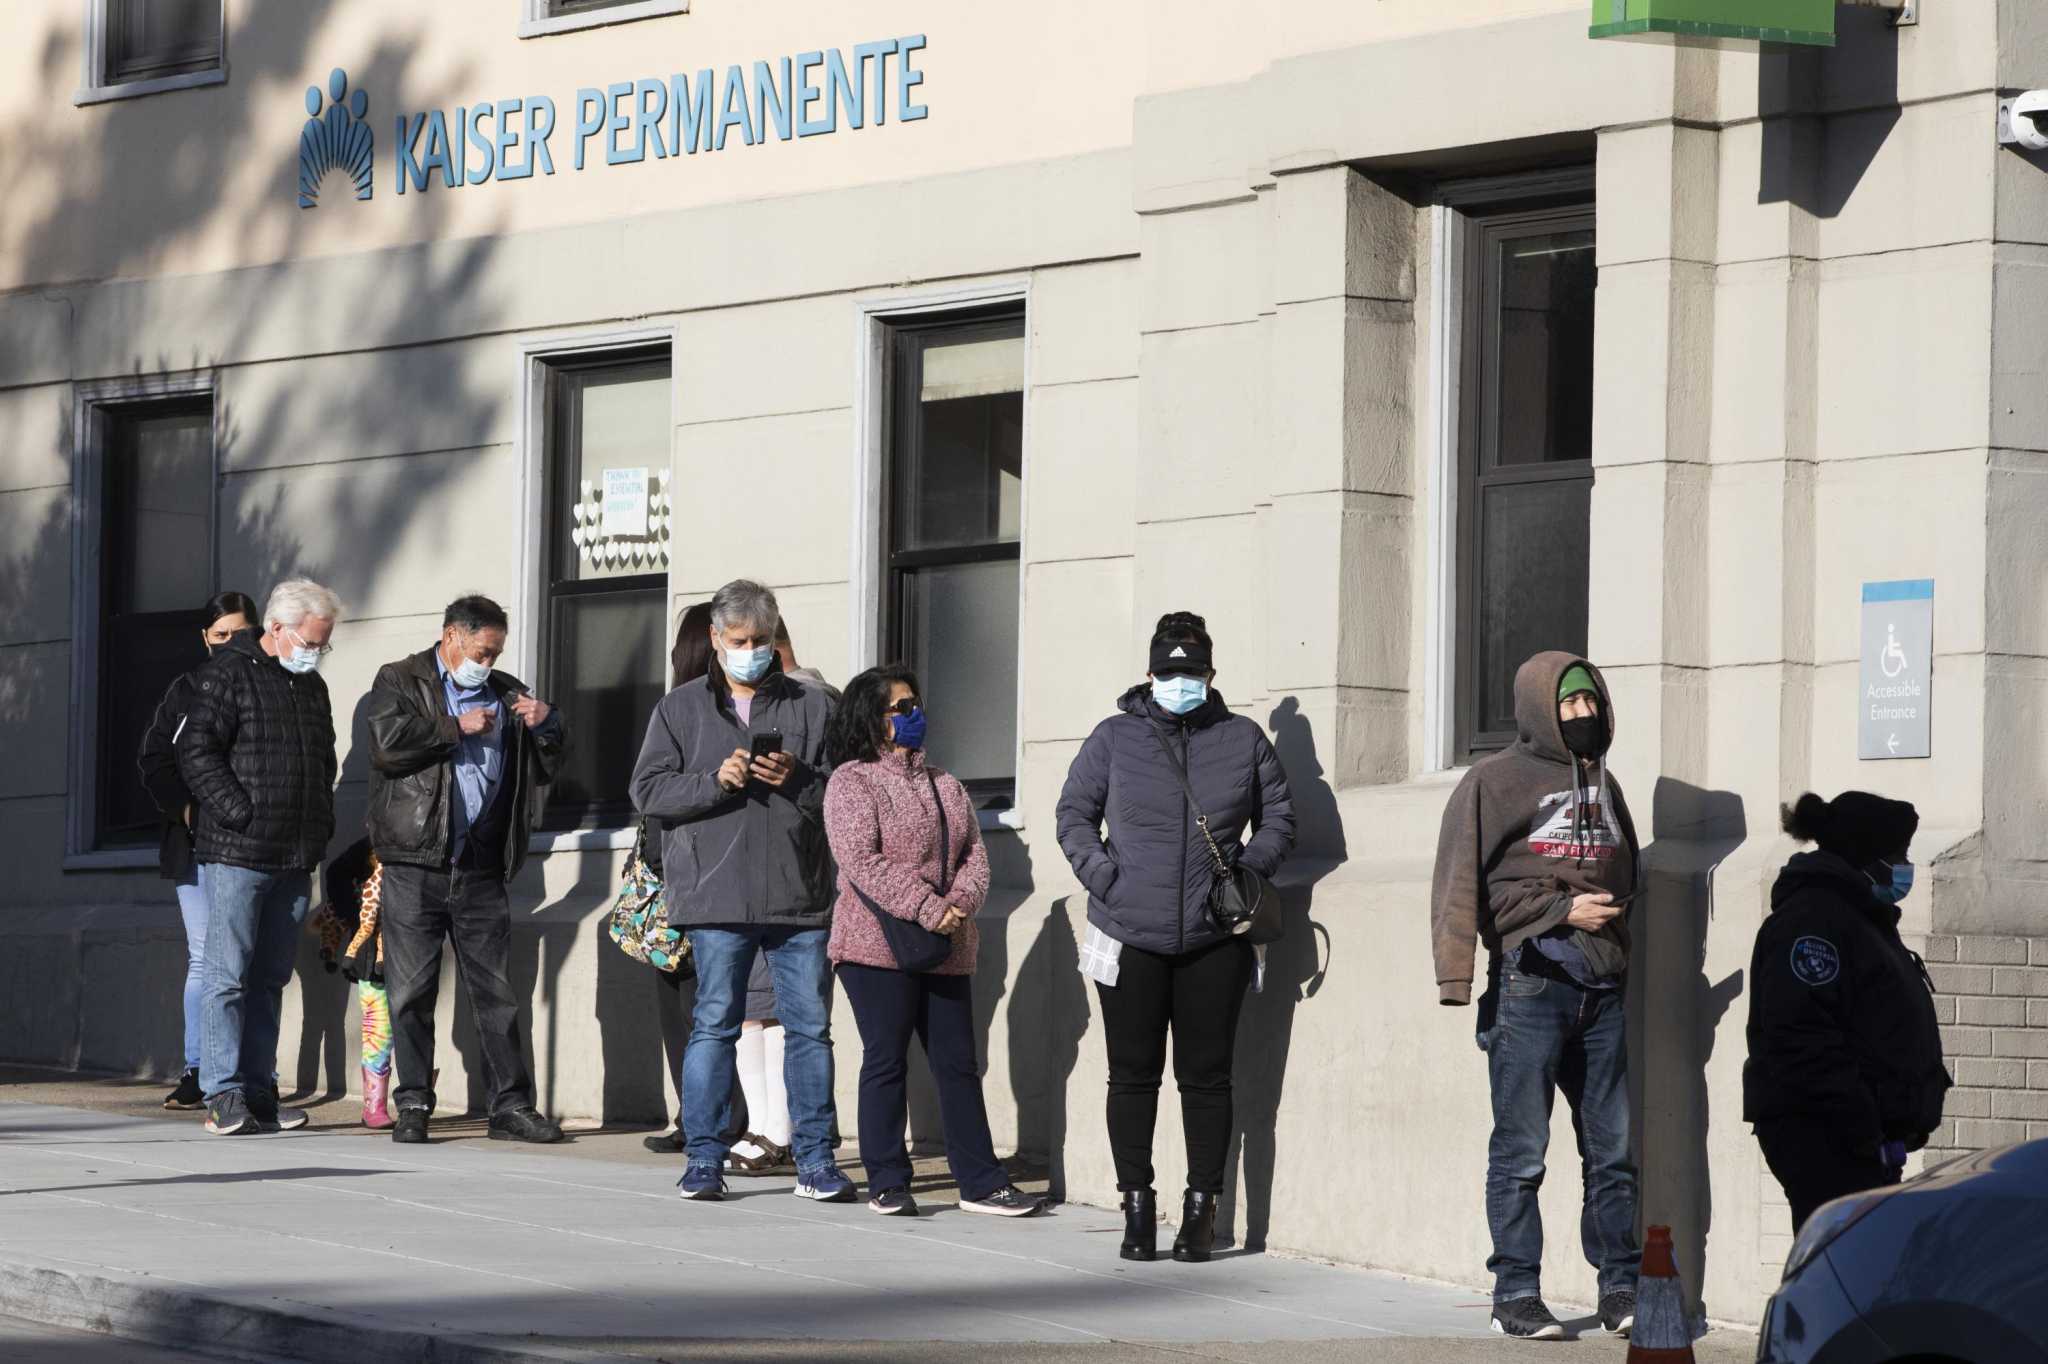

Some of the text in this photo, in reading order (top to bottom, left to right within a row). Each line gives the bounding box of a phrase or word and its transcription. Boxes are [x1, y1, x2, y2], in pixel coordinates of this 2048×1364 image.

[396, 33, 930, 194] KAISER PERMANENTE
[1867, 679, 1921, 698] Accessible
[1871, 704, 1917, 720] Entrance
[1549, 831, 1589, 841] CALIFOA
[1543, 843, 1565, 855] SAN
